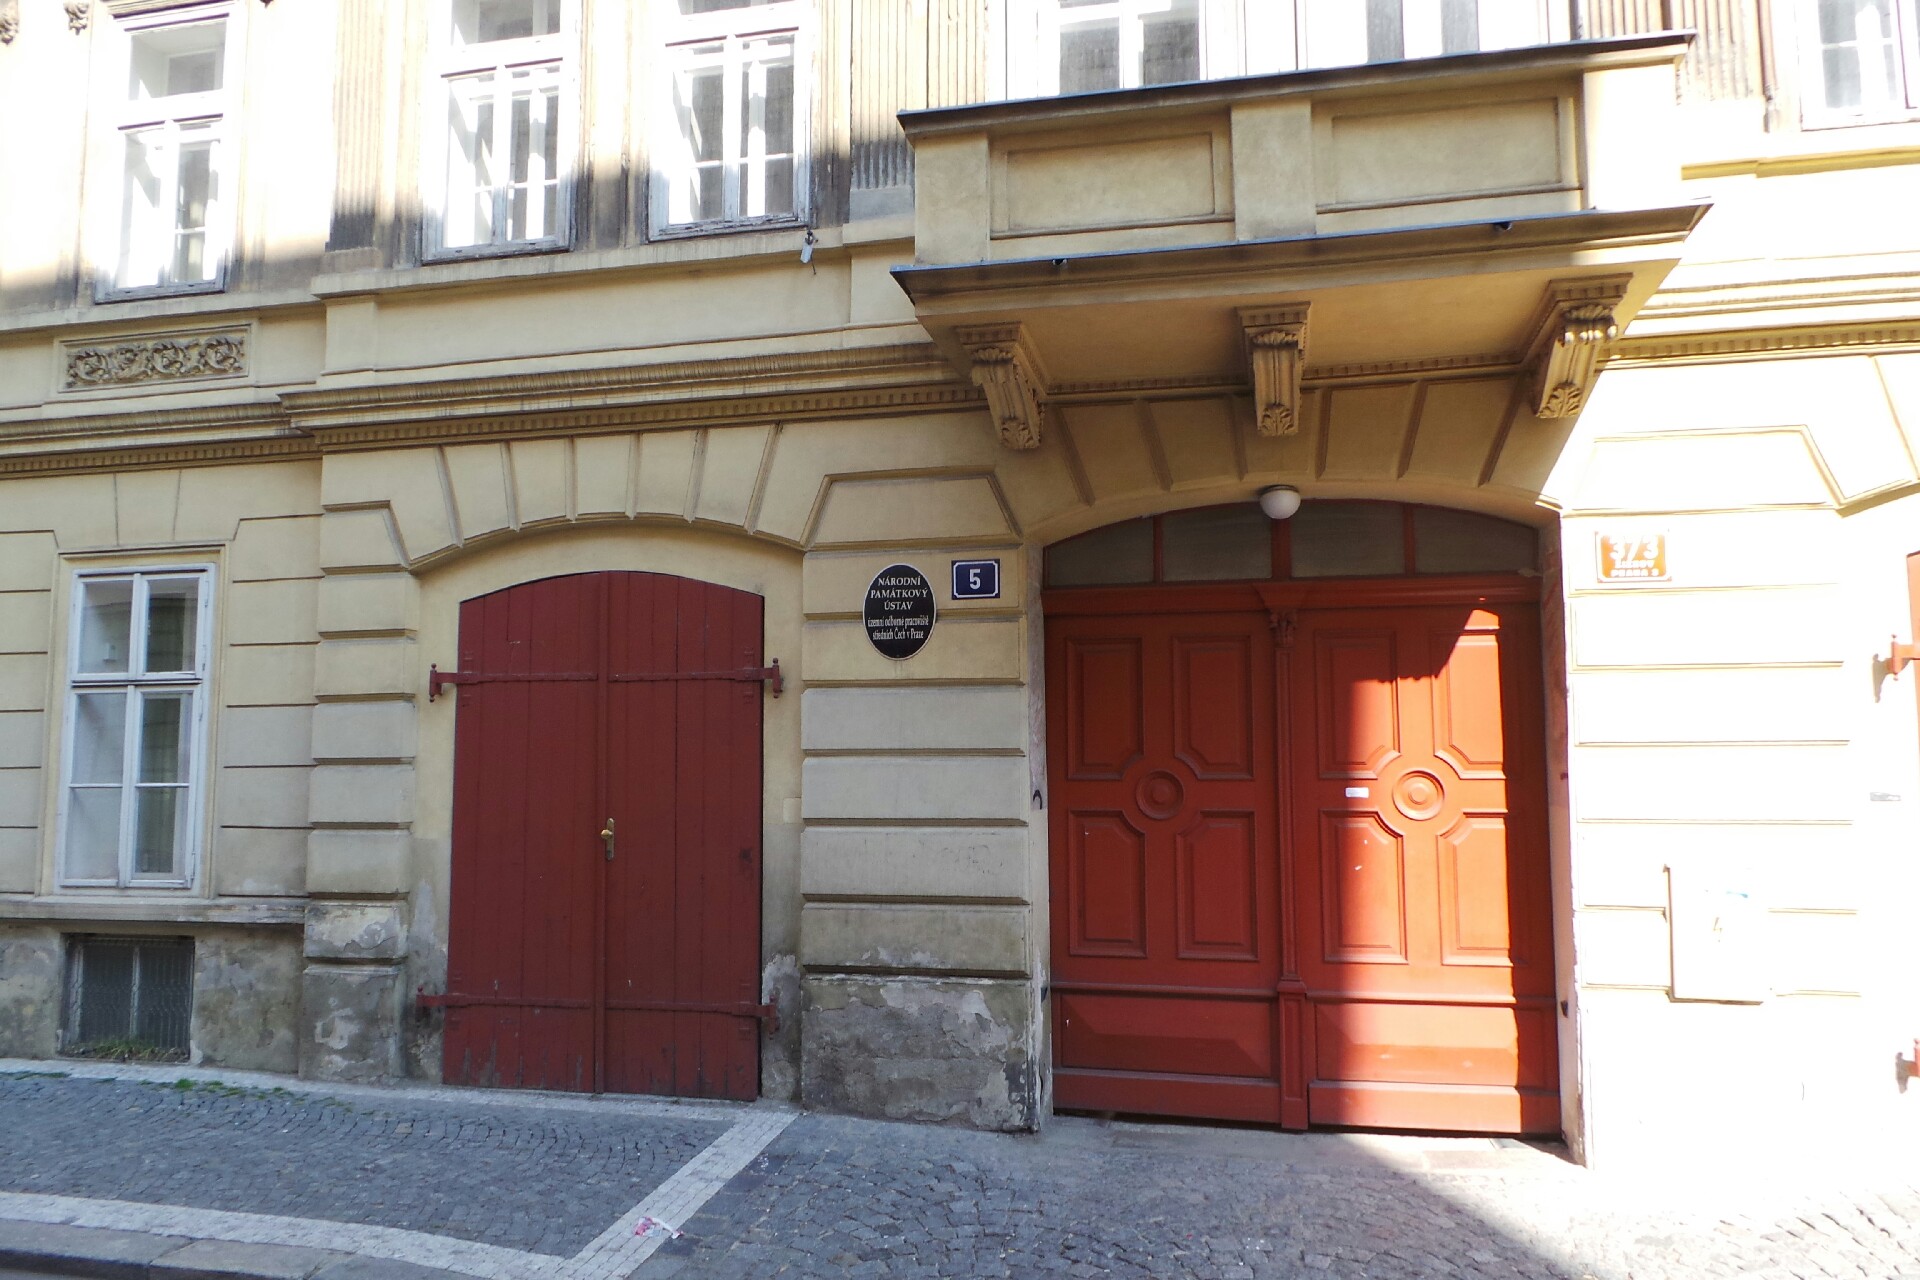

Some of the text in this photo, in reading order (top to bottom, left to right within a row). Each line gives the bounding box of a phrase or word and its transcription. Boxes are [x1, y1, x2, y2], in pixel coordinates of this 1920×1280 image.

[1609, 535, 1659, 561] 373
[878, 575, 921, 586] NÁRODNÍ
[969, 568, 981, 590] 5
[870, 588, 928, 599] PAMÁTKOVÝ
[884, 600, 913, 610] ÚSTAV
[884, 615, 905, 627] odborné
[894, 626, 906, 640] Čech
[910, 627, 924, 639] Praze
